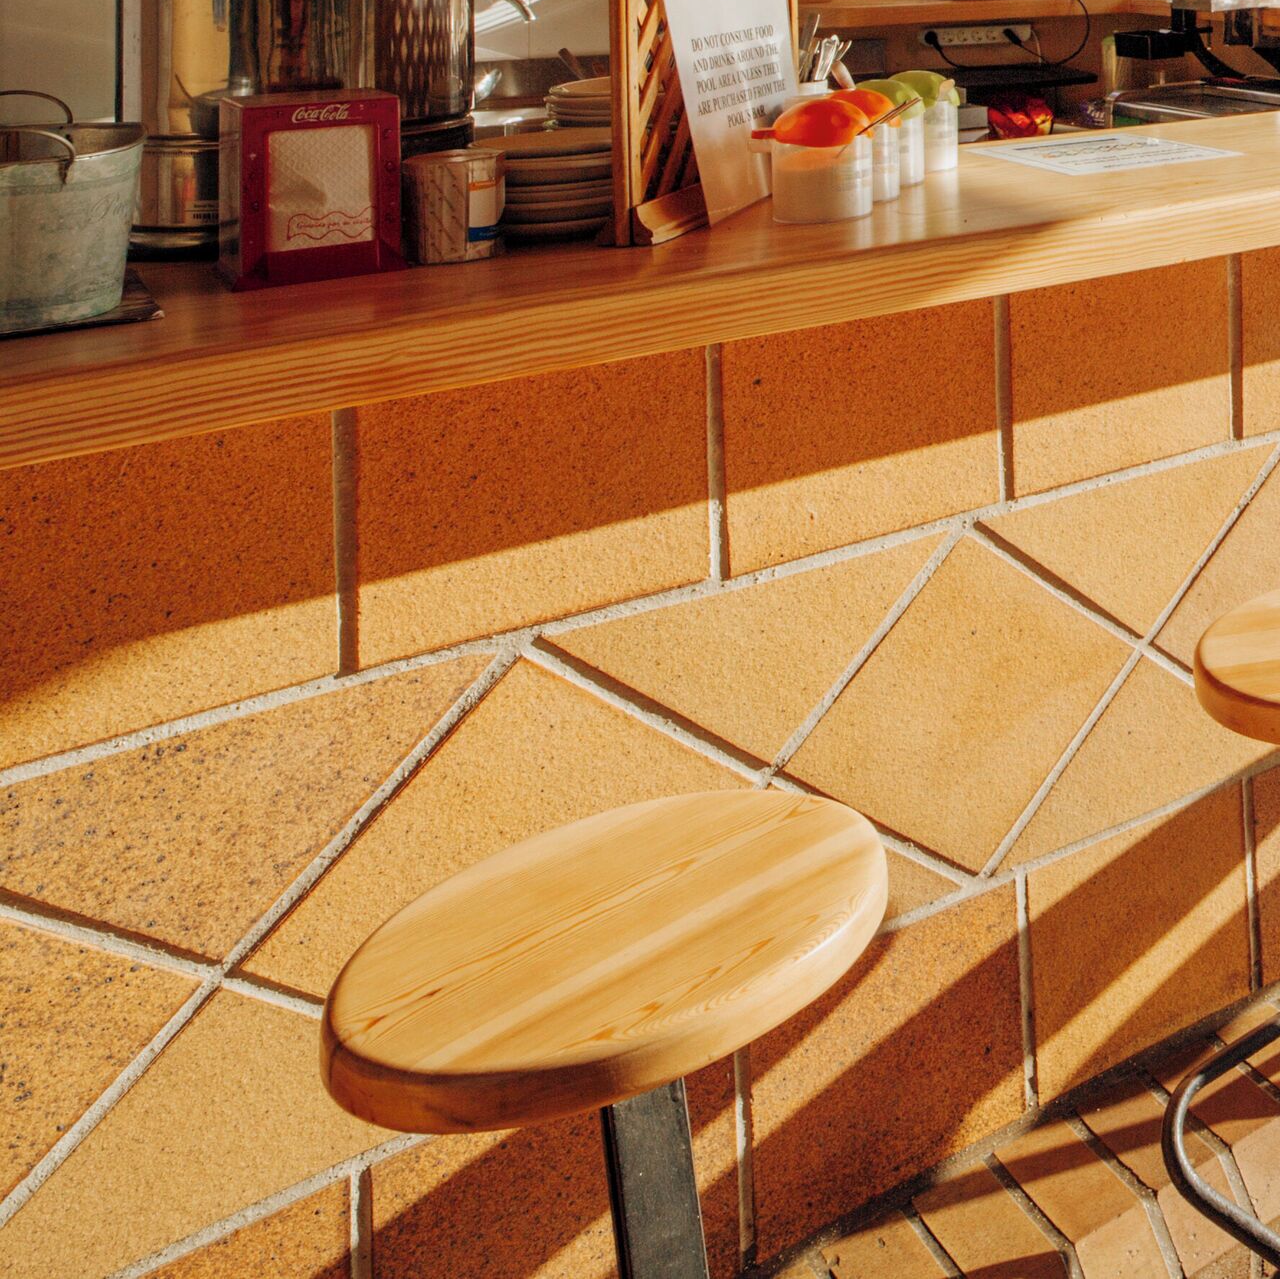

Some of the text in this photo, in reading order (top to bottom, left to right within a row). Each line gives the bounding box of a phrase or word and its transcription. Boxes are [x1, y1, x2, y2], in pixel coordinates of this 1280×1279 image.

[691, 24, 774, 52] DO NOT CONSUME FOOD
[693, 43, 779, 73] AND DRINKS AROUND THE
[696, 62, 780, 95] POOL AREA UNLESS THEY
[698, 79, 787, 117] ARE PURCHASED FROM THE
[752, 105, 766, 120] BAR
[292, 103, 350, 124] Coca-Cola
